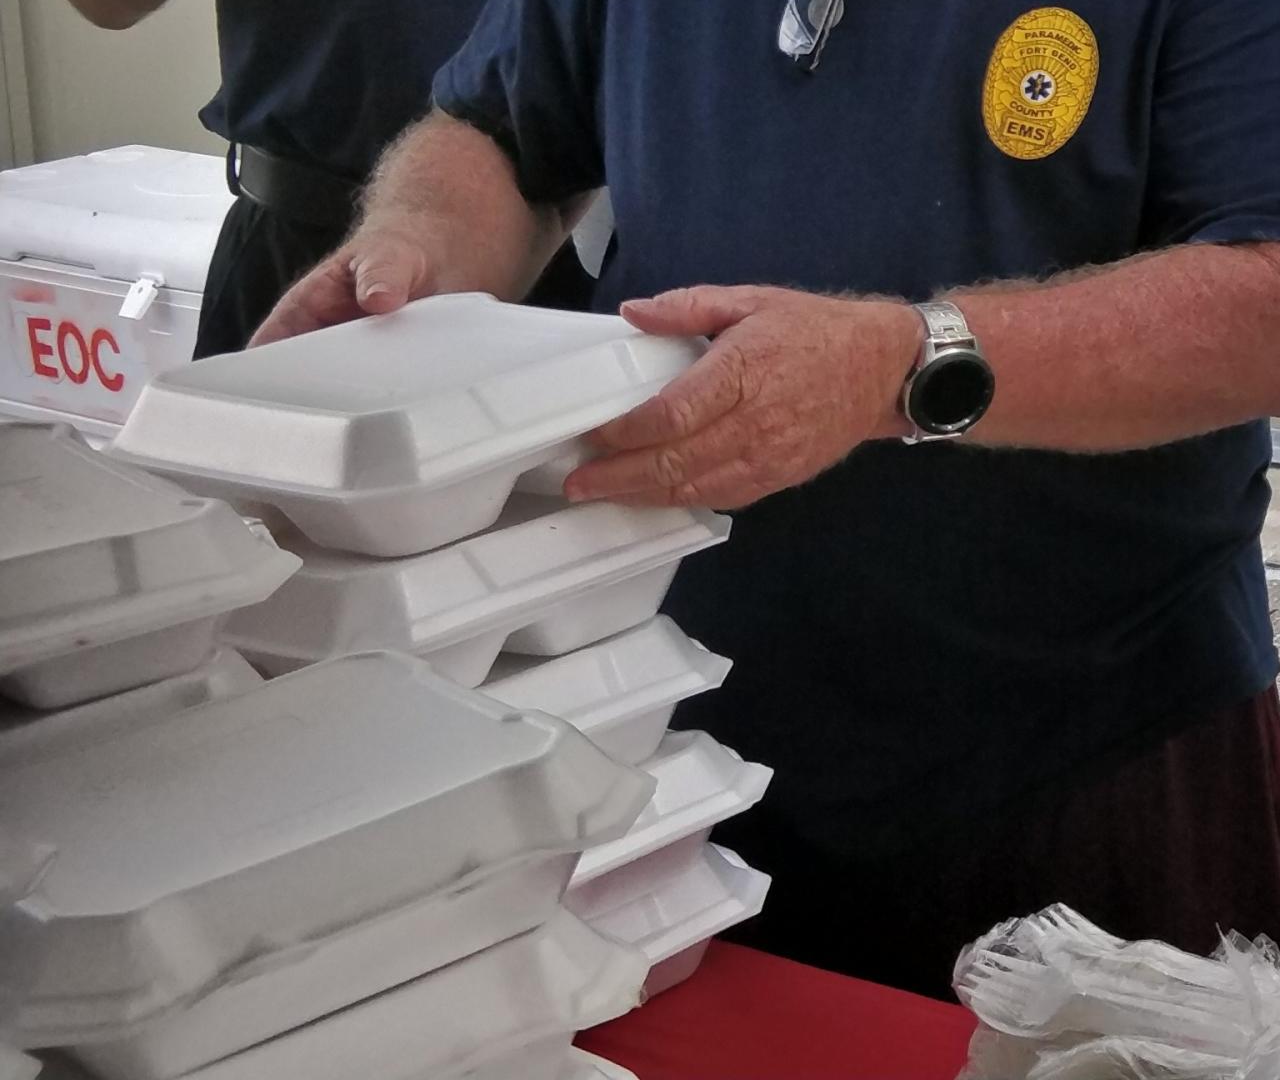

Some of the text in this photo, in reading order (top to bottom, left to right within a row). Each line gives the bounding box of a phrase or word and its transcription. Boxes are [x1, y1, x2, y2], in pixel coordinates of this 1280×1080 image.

[1024, 30, 1083, 55] PARAMEDIC
[1019, 46, 1077, 71] FORT BEND
[1009, 100, 1054, 118] COUNTY
[1006, 121, 1046, 141] EMS
[26, 317, 125, 393] EOC
